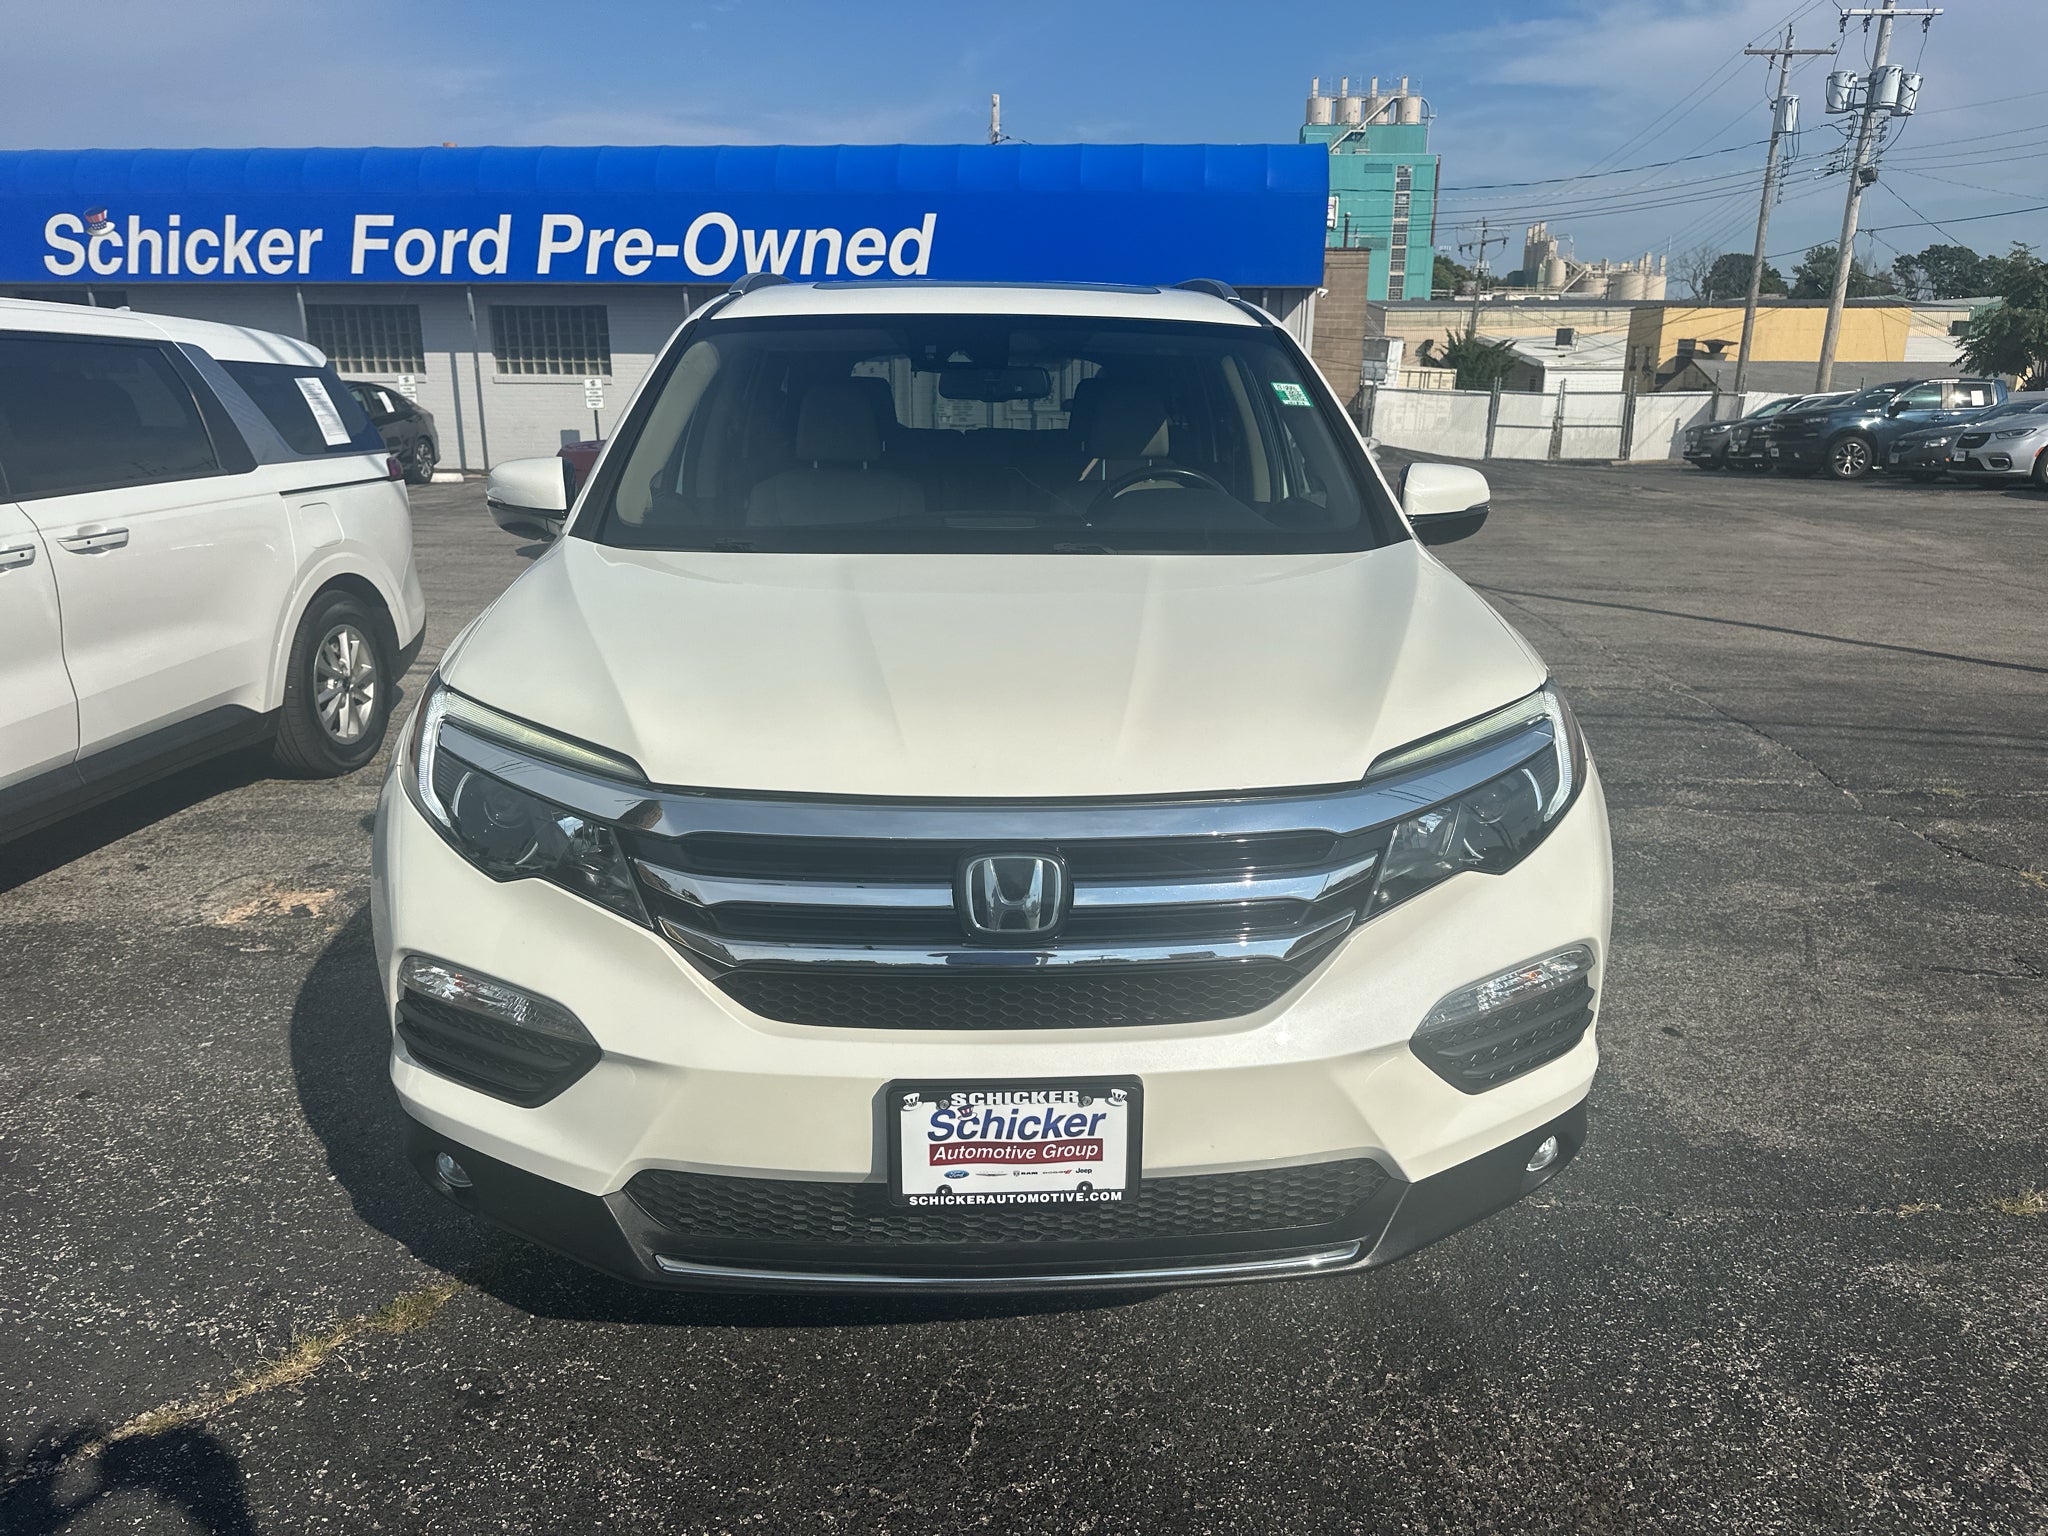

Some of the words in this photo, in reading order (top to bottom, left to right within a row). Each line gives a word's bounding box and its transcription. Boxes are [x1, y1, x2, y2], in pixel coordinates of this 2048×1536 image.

[43, 213, 322, 275] Schicker
[351, 214, 511, 276] Ford
[537, 212, 937, 277] Pre-Owned
[951, 1090, 1079, 1106] SCHICKER
[927, 1108, 1107, 1141] Schicker
[933, 1146, 1037, 1161] Automotive
[1042, 1143, 1098, 1159] Group
[909, 1191, 1122, 1206] SCHICKERAUTOMOTIVE.COM
